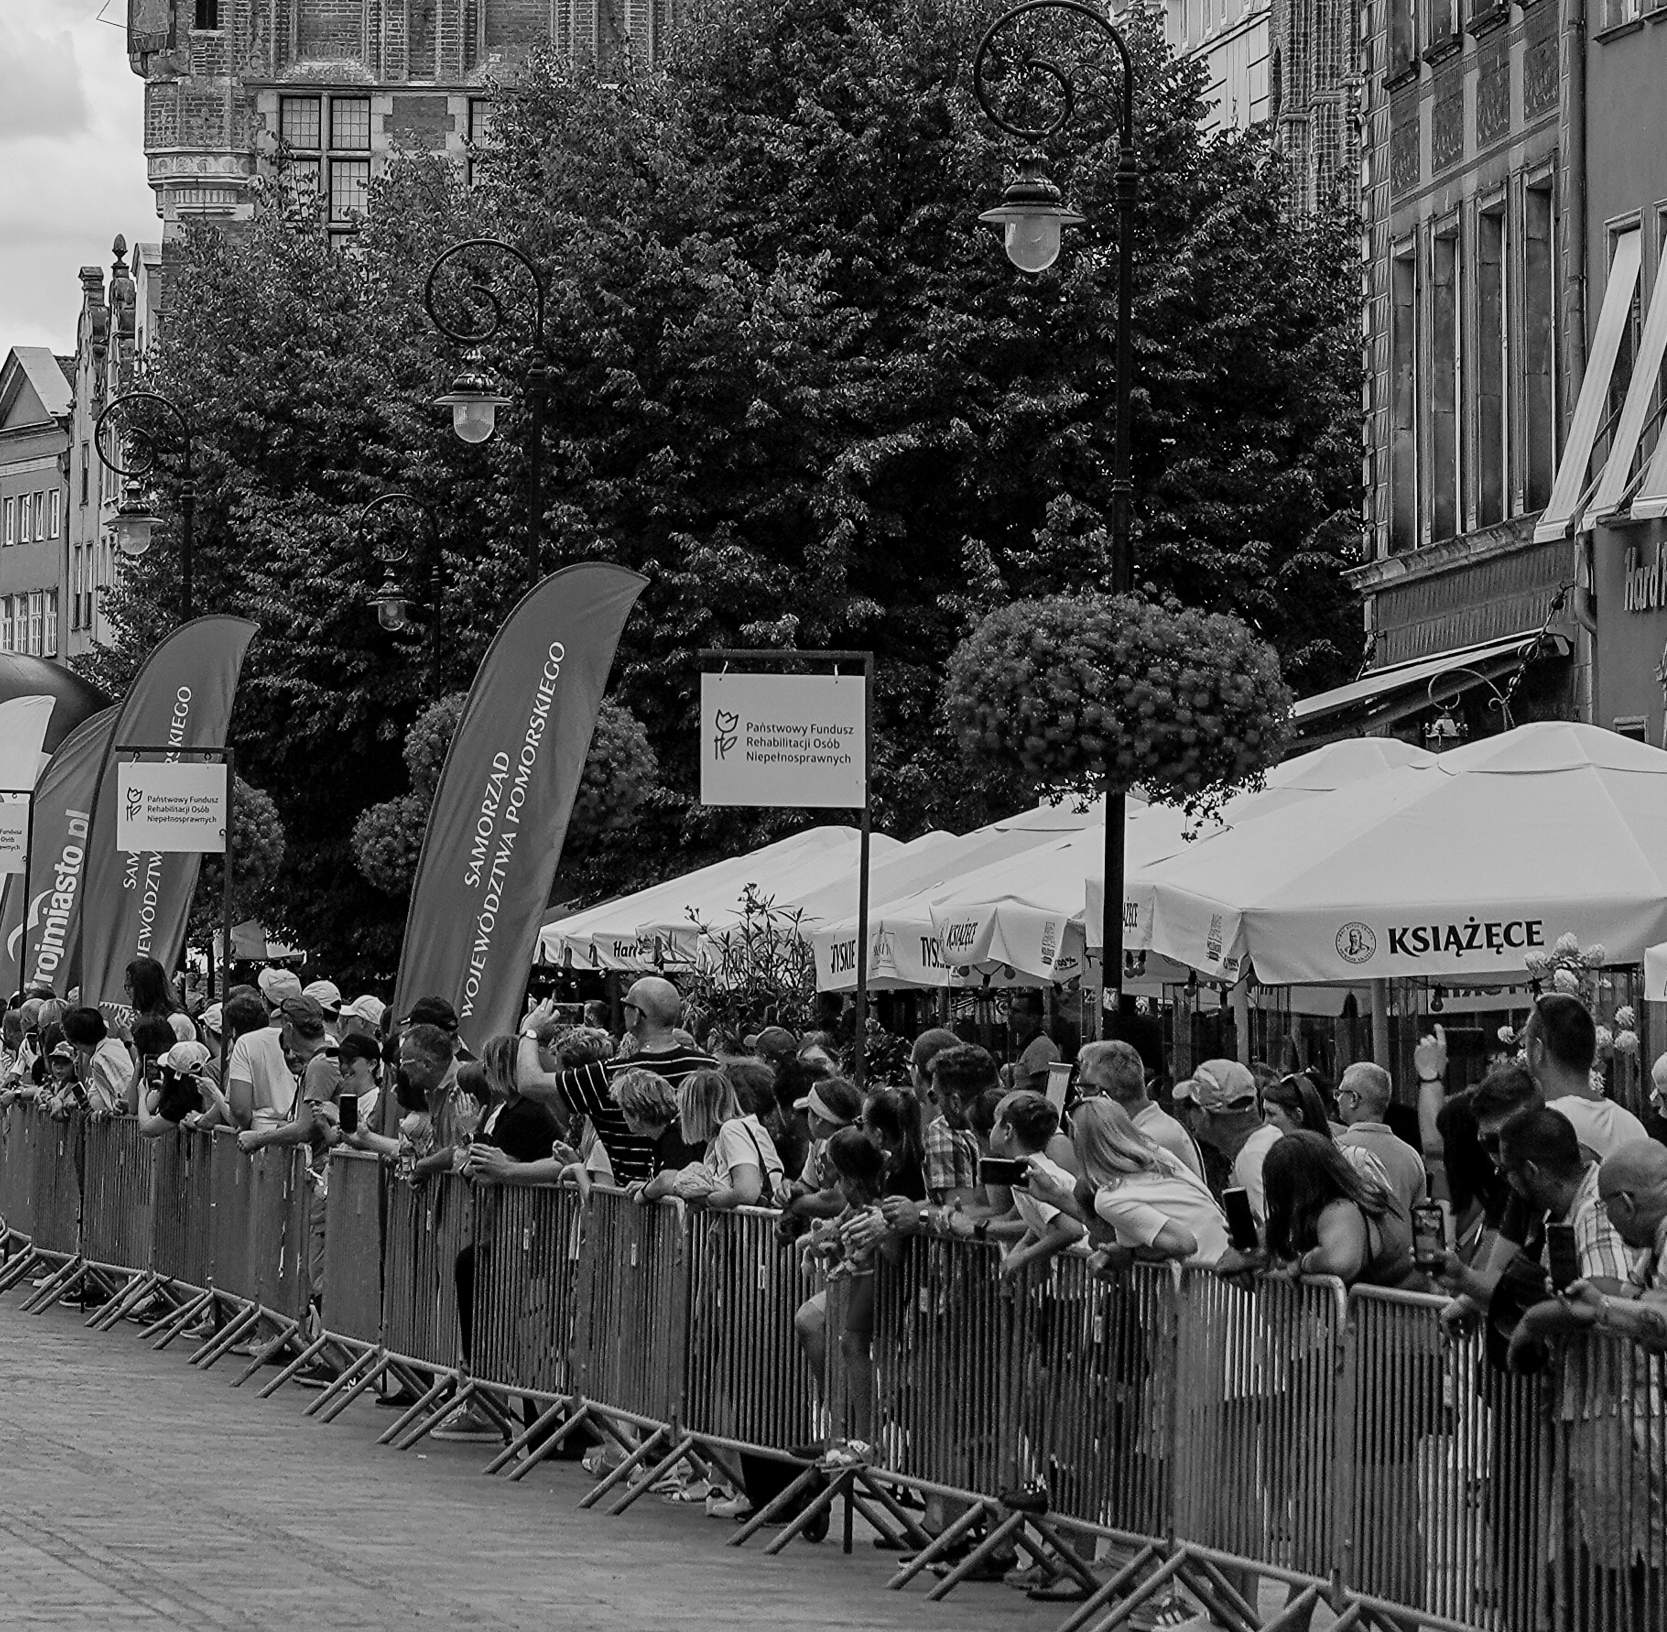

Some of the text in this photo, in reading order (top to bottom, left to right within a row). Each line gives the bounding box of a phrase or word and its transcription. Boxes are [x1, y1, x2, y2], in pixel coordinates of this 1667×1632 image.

[746, 721, 855, 737] Państwowy Fundusz
[746, 736, 841, 751] Rehabilitacji Osób
[746, 751, 852, 767] Niepełnosprawnych
[460, 640, 566, 1019] WOJEWÓDZTWA POMORSKIEGO
[464, 750, 510, 888] SAMORZĄD
[33, 844, 84, 984] rojmiasto
[1387, 916, 1545, 958] KSIĄŻĘCE
